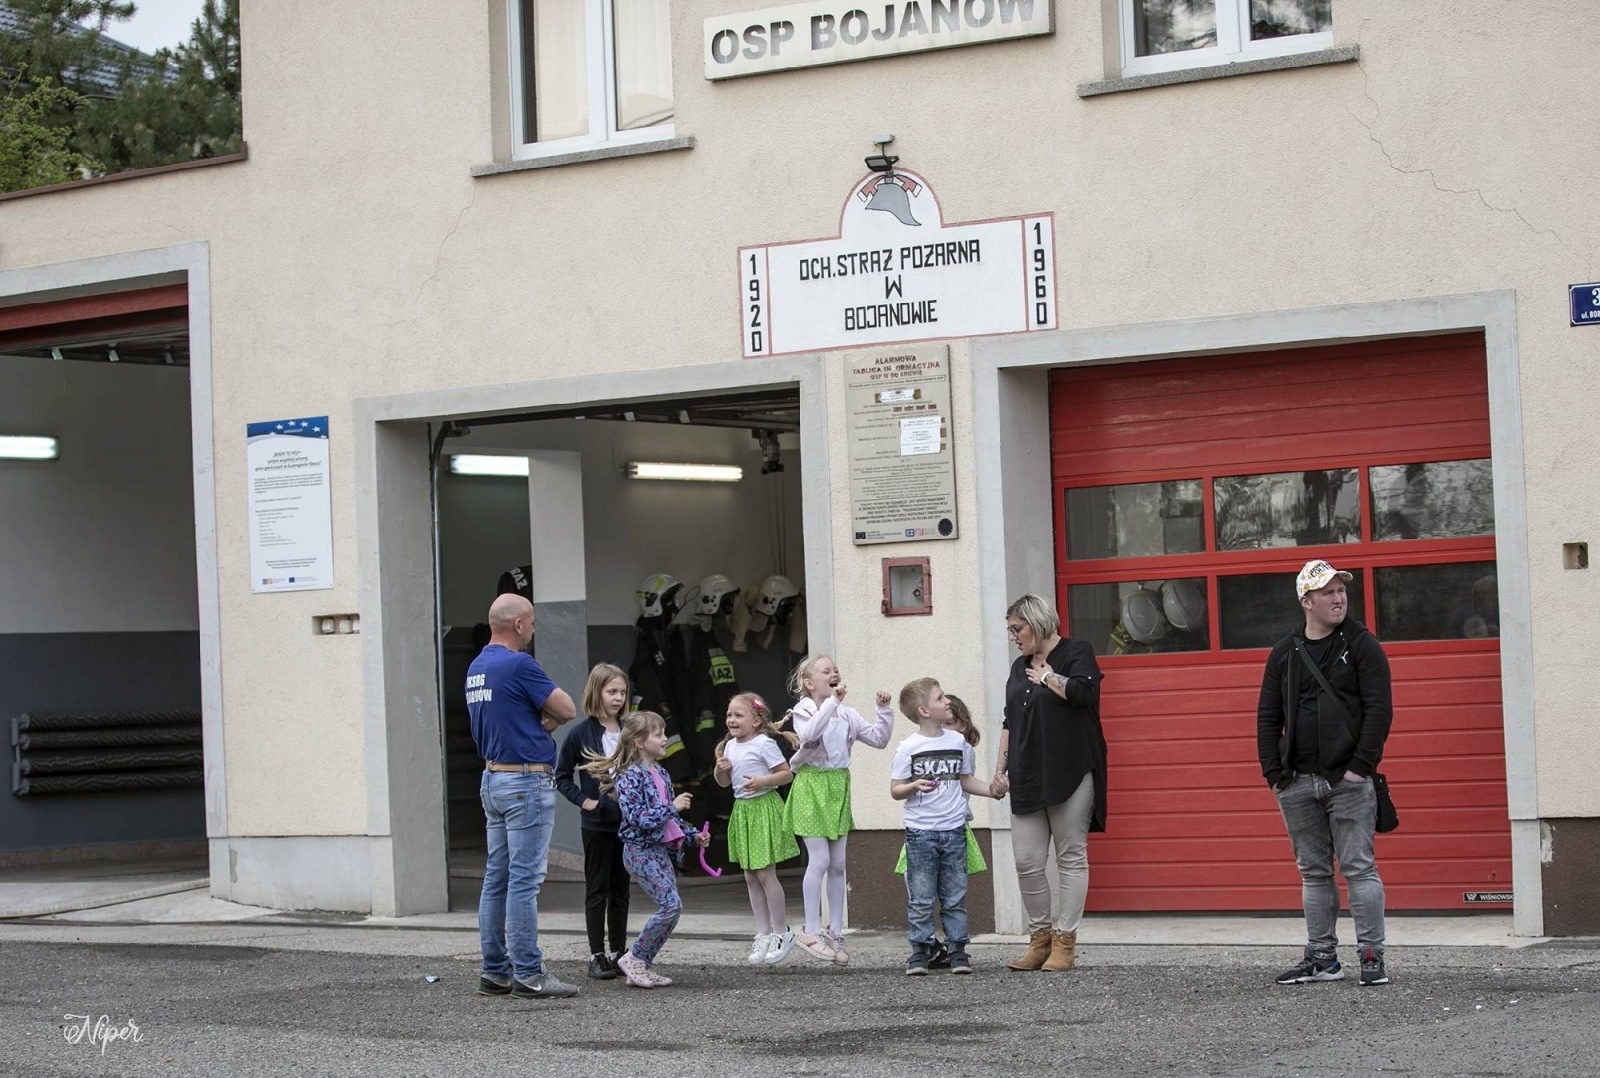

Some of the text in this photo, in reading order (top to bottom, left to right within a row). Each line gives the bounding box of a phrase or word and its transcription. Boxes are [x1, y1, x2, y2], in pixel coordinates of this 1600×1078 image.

[711, 20, 794, 64] OSP
[885, 275, 902, 299] W
[1033, 222, 1048, 325] 1960
[749, 254, 763, 353] 1920
[844, 300, 938, 331] BOJANOWIE
[852, 361, 940, 375] TABLICA INORMACYJNA
[875, 355, 917, 365] ALARMOWA
[890, 370, 923, 379] BOANOWIE
